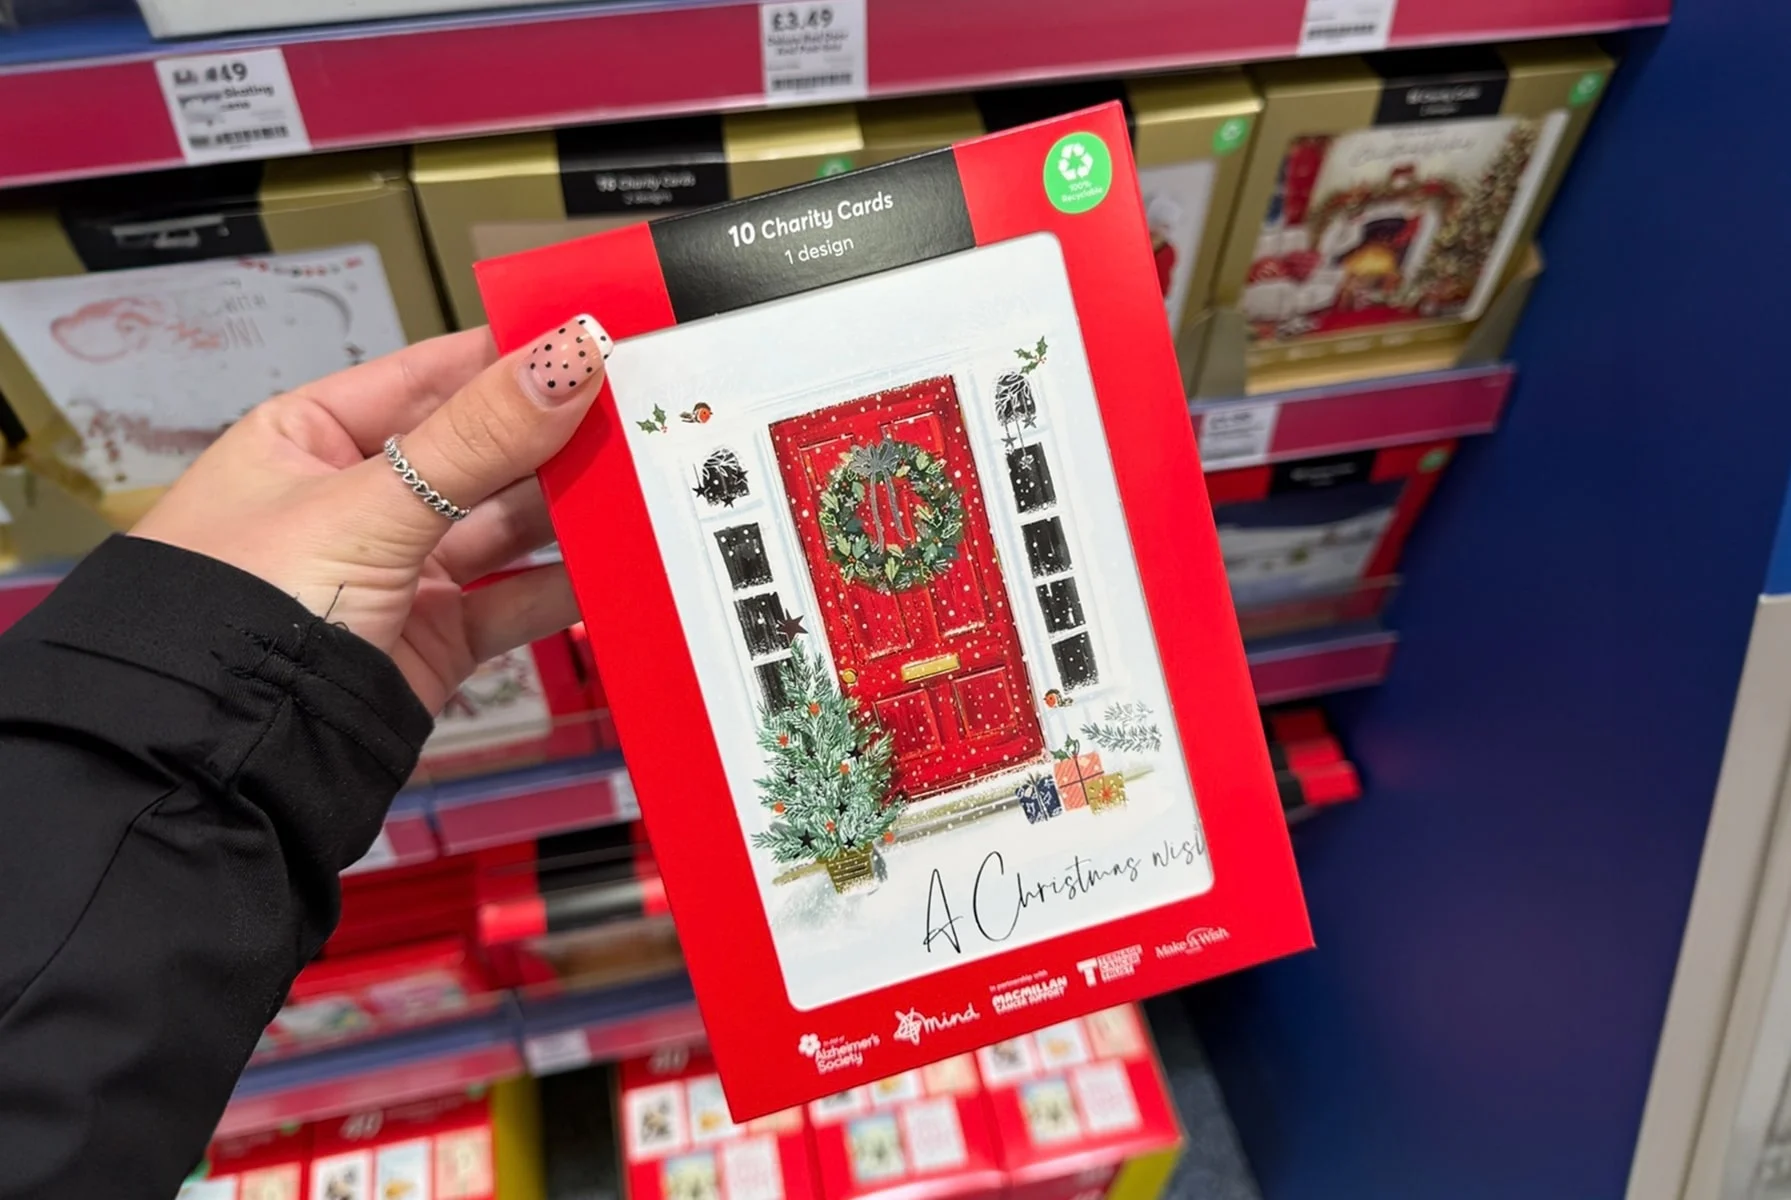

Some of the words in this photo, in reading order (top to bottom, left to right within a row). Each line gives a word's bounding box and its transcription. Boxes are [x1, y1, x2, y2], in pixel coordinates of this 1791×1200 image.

[1061, 186, 1104, 203] Recyclable
[728, 221, 756, 247] 10
[761, 209, 833, 239] Charity
[837, 191, 894, 220] Cards
[785, 250, 794, 265] 1
[798, 238, 854, 262] design
[923, 868, 964, 954] A
[973, 850, 1142, 942] Christmas
[992, 975, 1067, 1009] MACMILLAN
[923, 1002, 981, 1034] mind
[814, 1033, 881, 1063] Alzheimer's
[817, 1050, 863, 1075] Society
